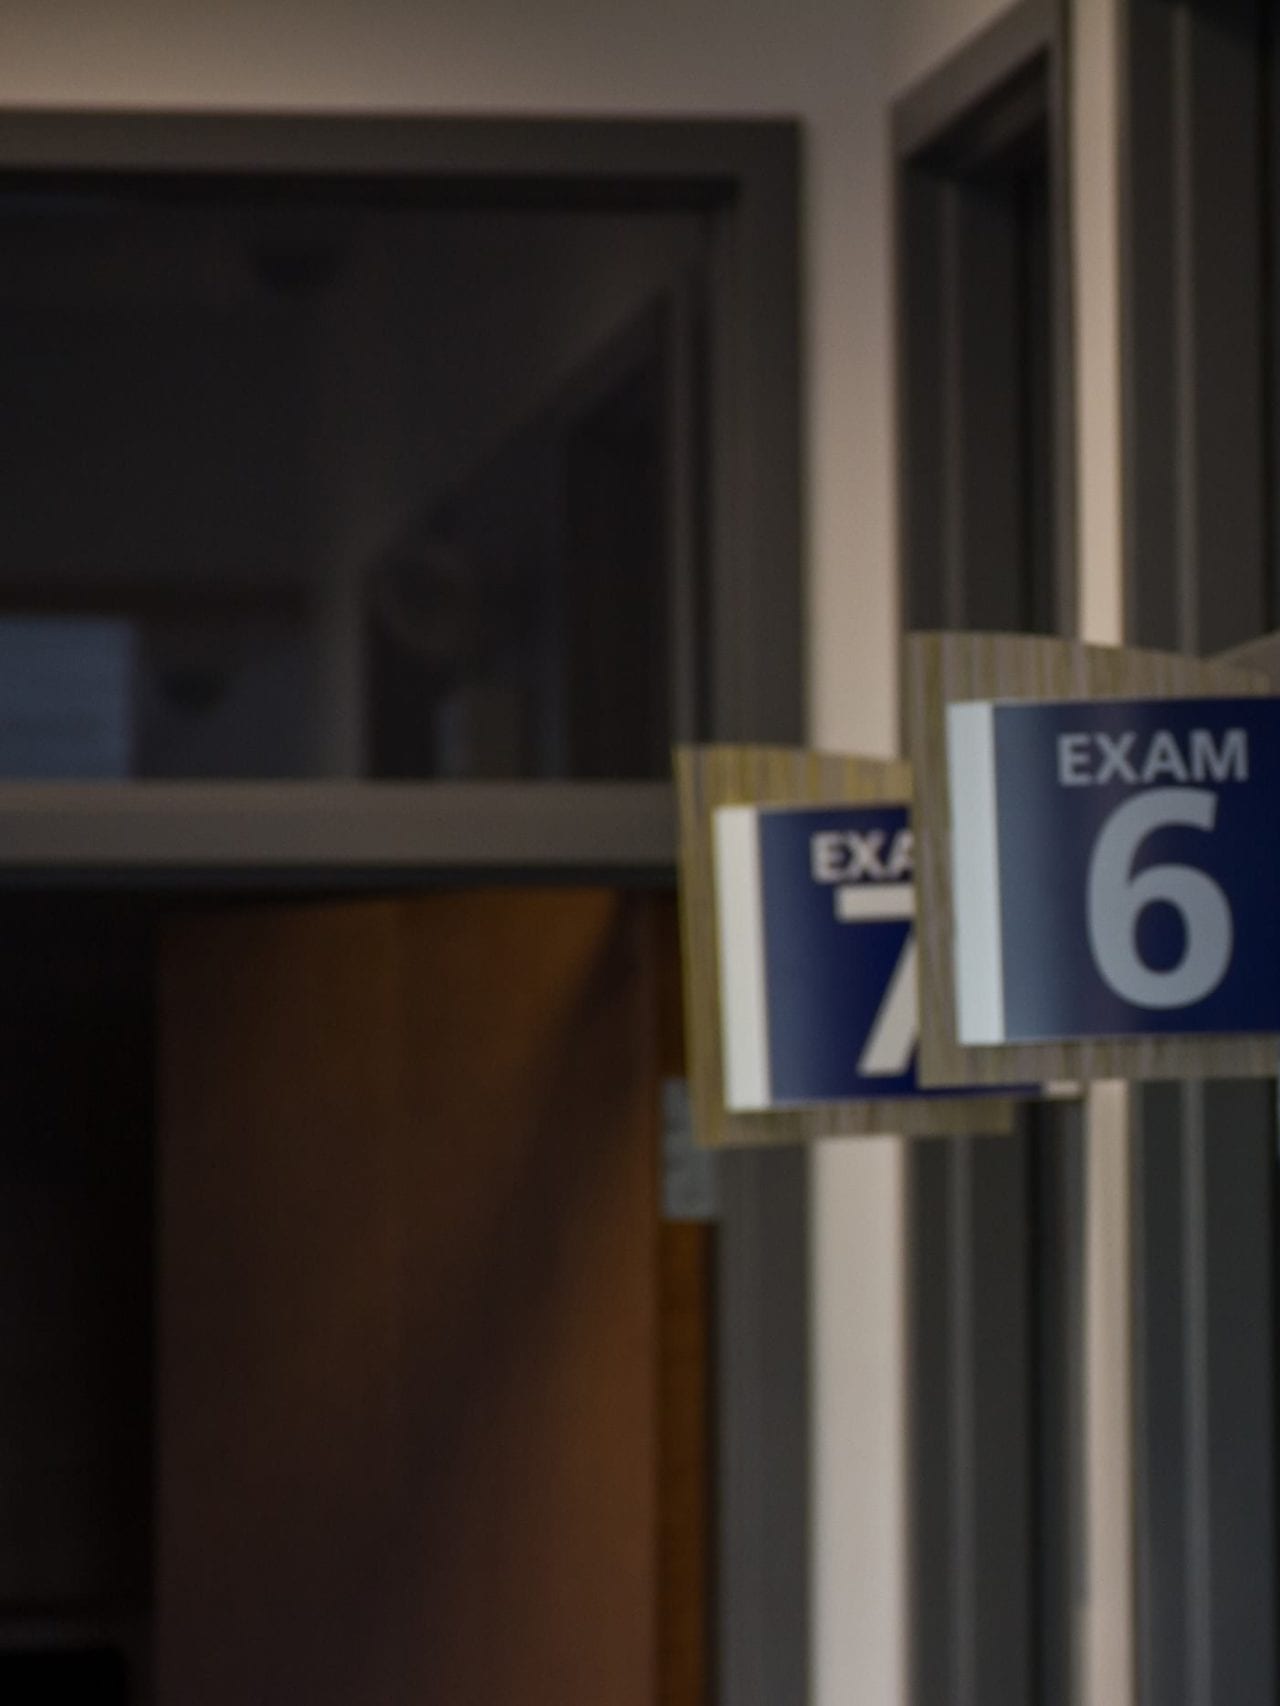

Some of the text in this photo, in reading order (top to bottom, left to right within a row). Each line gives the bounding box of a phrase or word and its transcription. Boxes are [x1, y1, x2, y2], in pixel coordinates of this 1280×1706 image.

[1058, 729, 1248, 785] EXAM
[812, 830, 914, 883] EXA
[1087, 787, 1233, 1010] 6
[835, 884, 918, 1076] 7
